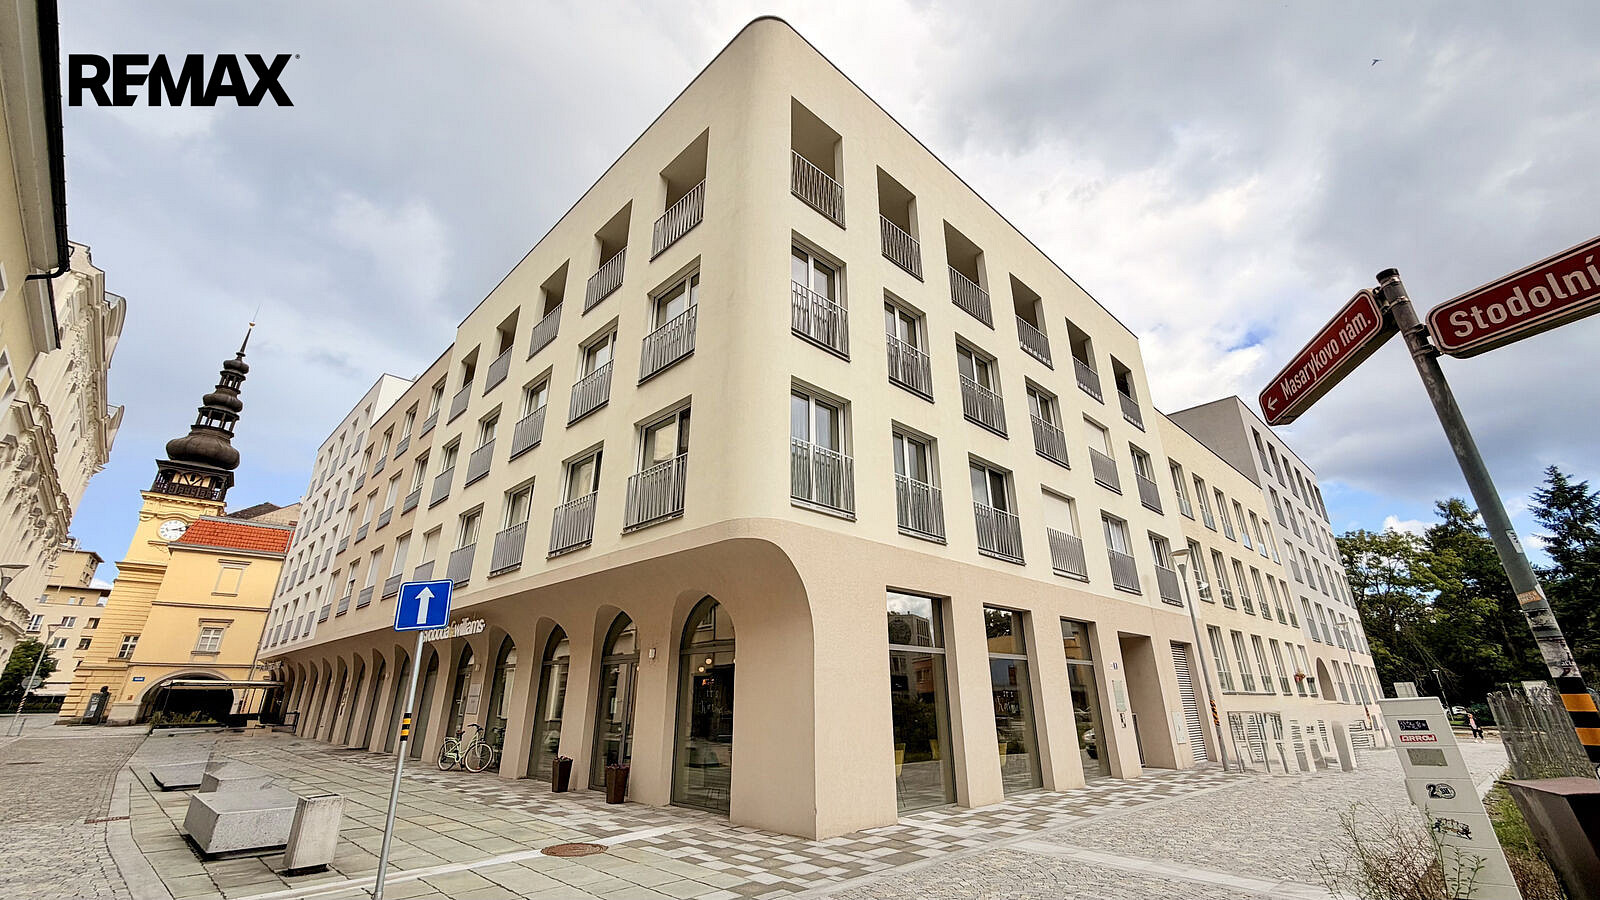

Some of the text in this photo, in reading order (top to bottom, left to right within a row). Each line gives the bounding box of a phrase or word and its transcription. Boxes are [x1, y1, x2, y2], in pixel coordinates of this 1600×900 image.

[1450, 255, 1600, 337] Stodolní
[1280, 312, 1371, 401] Masarykovo nám.
